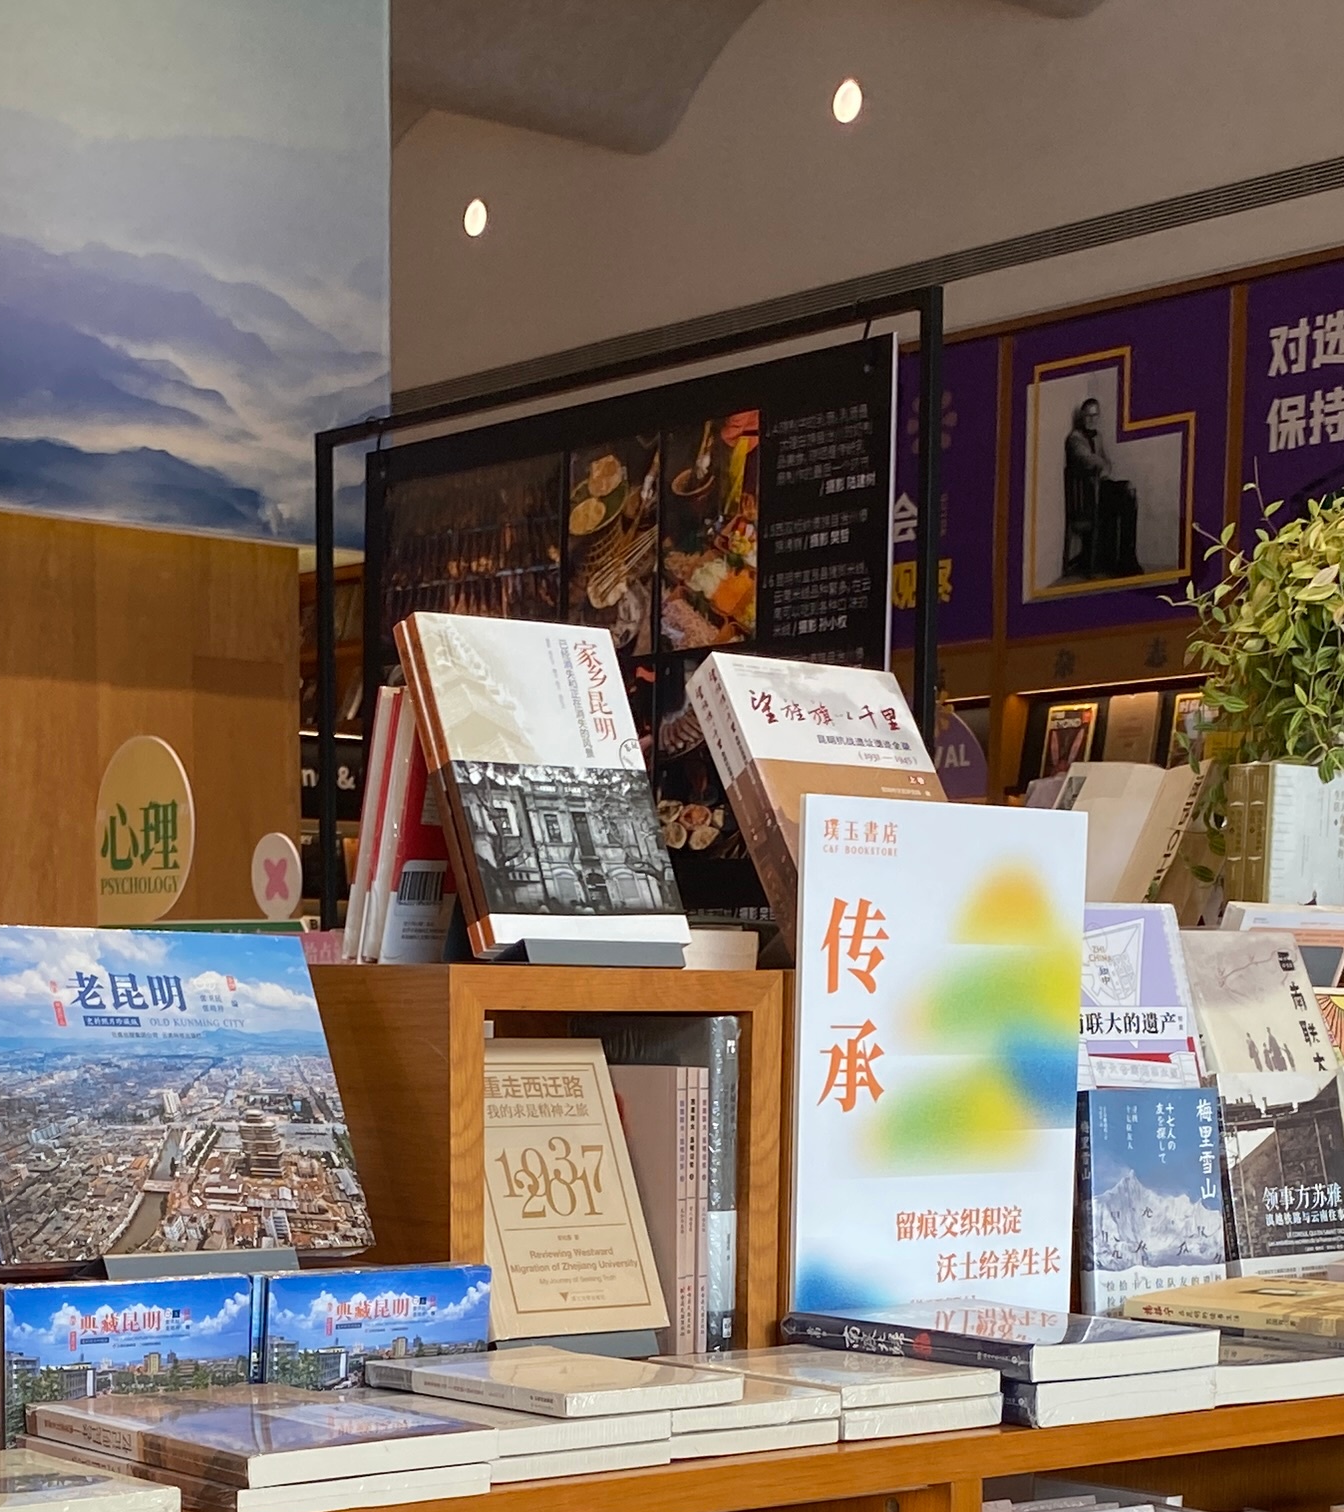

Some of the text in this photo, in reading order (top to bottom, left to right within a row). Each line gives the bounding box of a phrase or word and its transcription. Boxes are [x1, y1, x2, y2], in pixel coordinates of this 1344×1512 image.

[571, 638, 618, 743] 家乡昆明
[100, 799, 181, 871] 心理
[823, 816, 899, 846] 璞玉書店
[100, 874, 180, 896] PSYCHOLOGY
[65, 970, 189, 1012] 老昆明
[817, 896, 891, 1115] 传承
[173, 1017, 221, 1028] KUNMING
[222, 1017, 246, 1029] CITY
[484, 1074, 585, 1100] 重走西迁路
[1196, 1098, 1218, 1200] 梅里雪山
[1262, 1182, 1343, 1210] 领事方苏雅
[895, 1204, 1023, 1243] 留痕交织积淀
[509, 1257, 639, 1275] Migration of Zhejiang University
[935, 1249, 1063, 1286] 沃土给养生长
[79, 1308, 162, 1336] 典藏昆明
[336, 1297, 411, 1323] 典藏昆明
